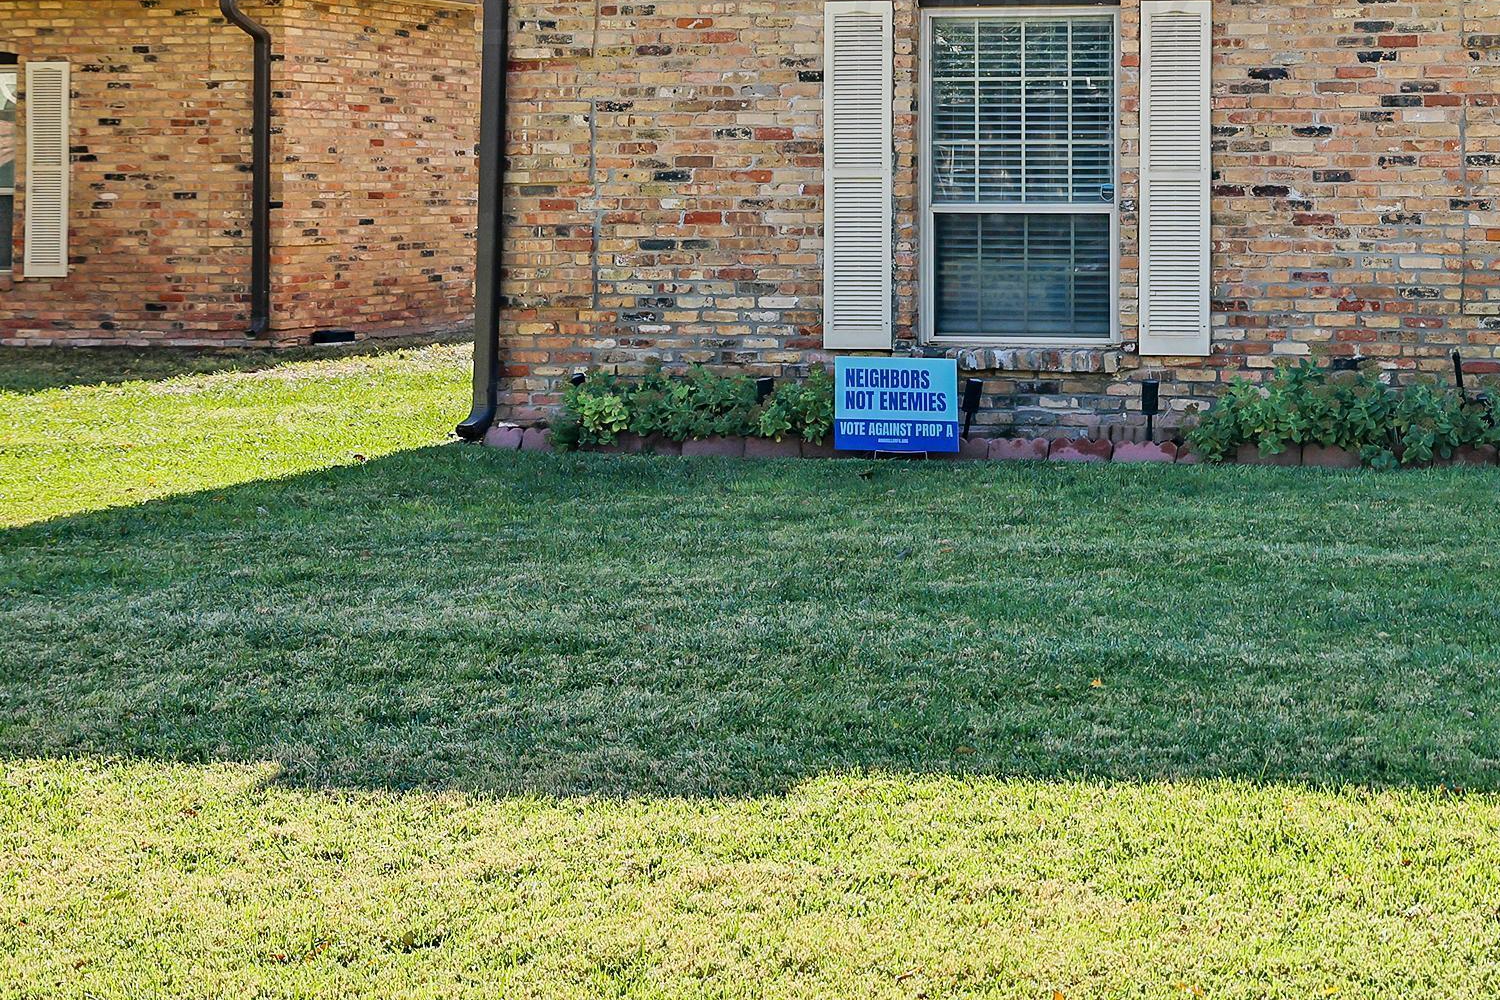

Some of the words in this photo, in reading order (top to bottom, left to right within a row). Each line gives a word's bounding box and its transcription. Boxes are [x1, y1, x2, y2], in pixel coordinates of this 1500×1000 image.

[845, 368, 930, 389] NEIGHBORS
[845, 391, 874, 410] NOT
[880, 391, 947, 412] ENEMIES
[840, 421, 866, 436] VOTE
[868, 422, 912, 437] AGAINST
[916, 423, 943, 437] PROP
[946, 424, 953, 438] A
